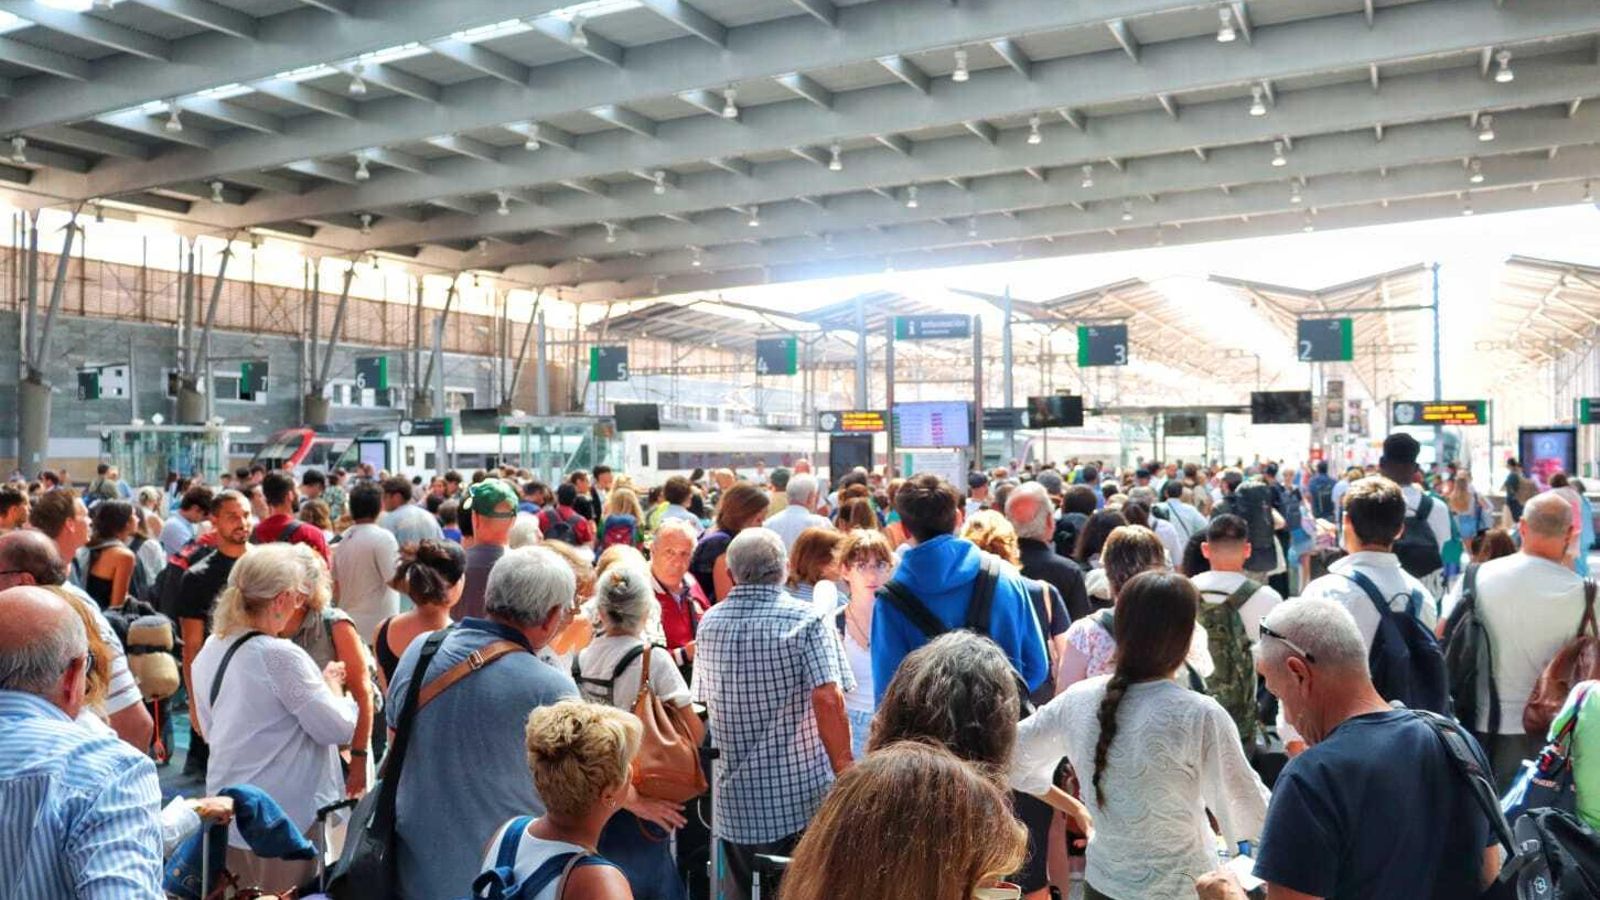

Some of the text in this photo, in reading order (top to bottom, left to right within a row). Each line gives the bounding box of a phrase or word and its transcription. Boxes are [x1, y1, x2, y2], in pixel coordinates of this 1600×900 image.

[1114, 344, 1126, 364] 3
[1300, 340, 1312, 360] 2
[617, 362, 627, 380] 5
[758, 356, 768, 373] 4
[260, 376, 268, 390] 7
[357, 372, 366, 389] 6
